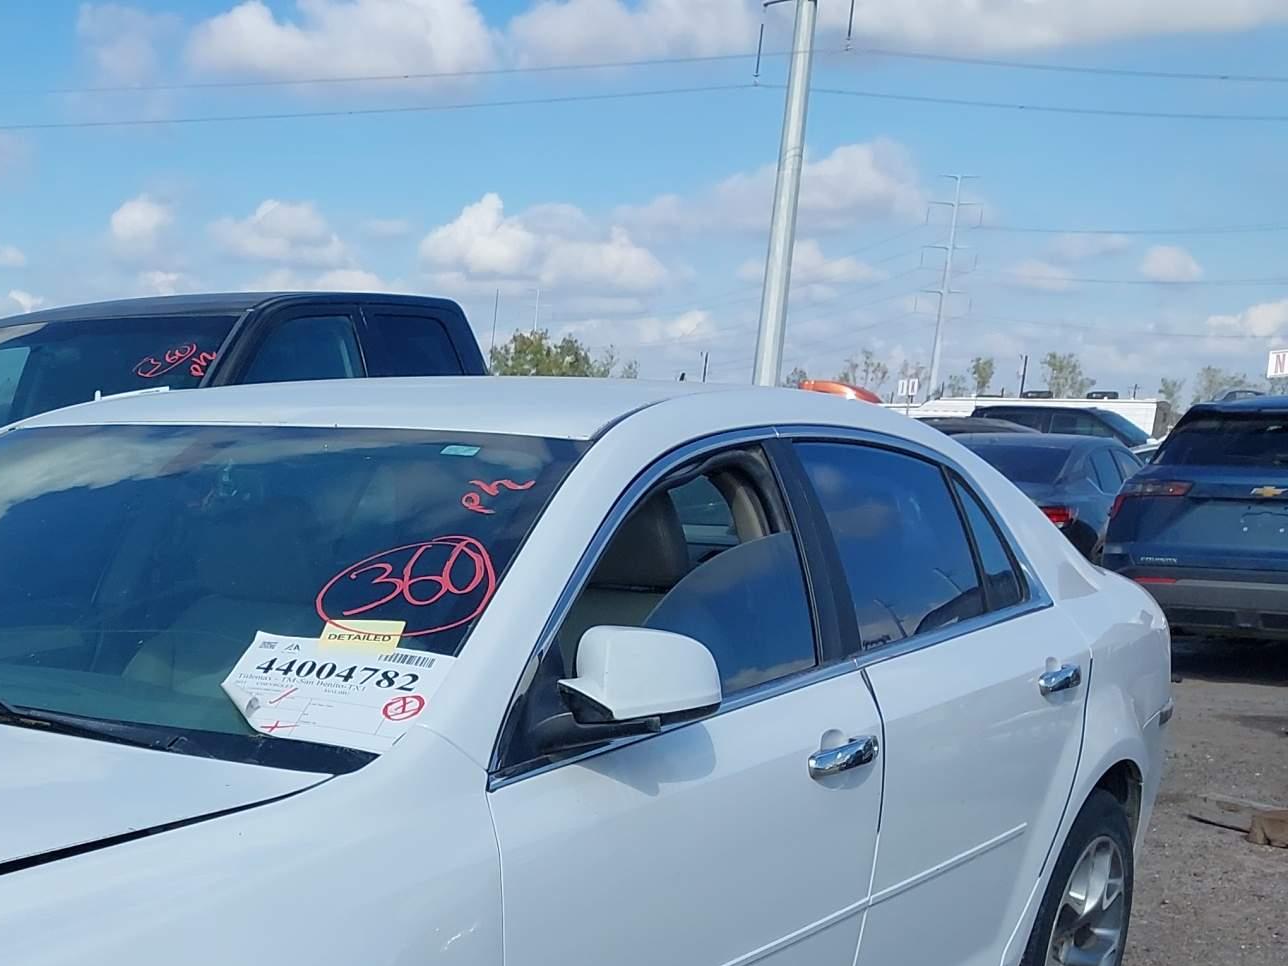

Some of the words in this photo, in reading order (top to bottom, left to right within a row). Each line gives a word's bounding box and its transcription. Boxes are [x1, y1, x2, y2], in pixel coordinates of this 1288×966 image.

[138, 345, 191, 376] 360
[342, 541, 485, 616] 360
[328, 633, 392, 642] DETAILED
[256, 657, 419, 692] 44004782
